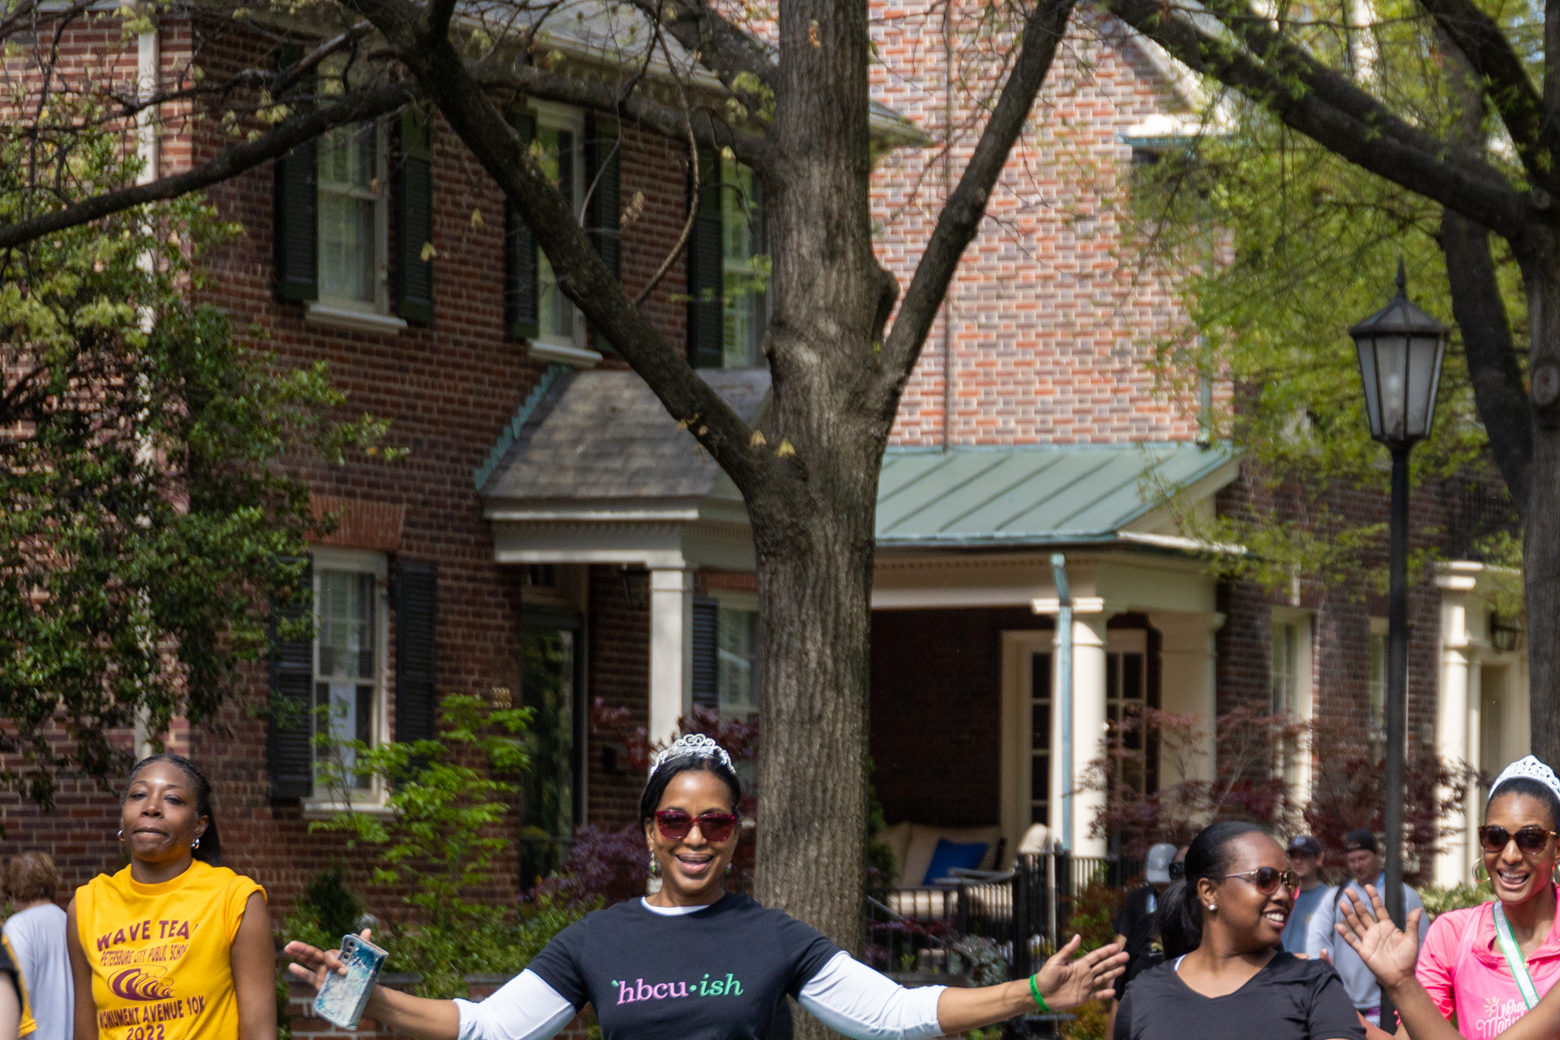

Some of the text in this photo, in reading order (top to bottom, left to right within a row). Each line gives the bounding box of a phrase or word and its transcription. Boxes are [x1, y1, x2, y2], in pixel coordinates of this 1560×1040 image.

[96, 919, 199, 952] WAVE TEA
[133, 949, 147, 963] CITY
[148, 944, 169, 961] PUBLIC
[143, 999, 185, 1023] AVENUE
[186, 995, 206, 1016] 10K
